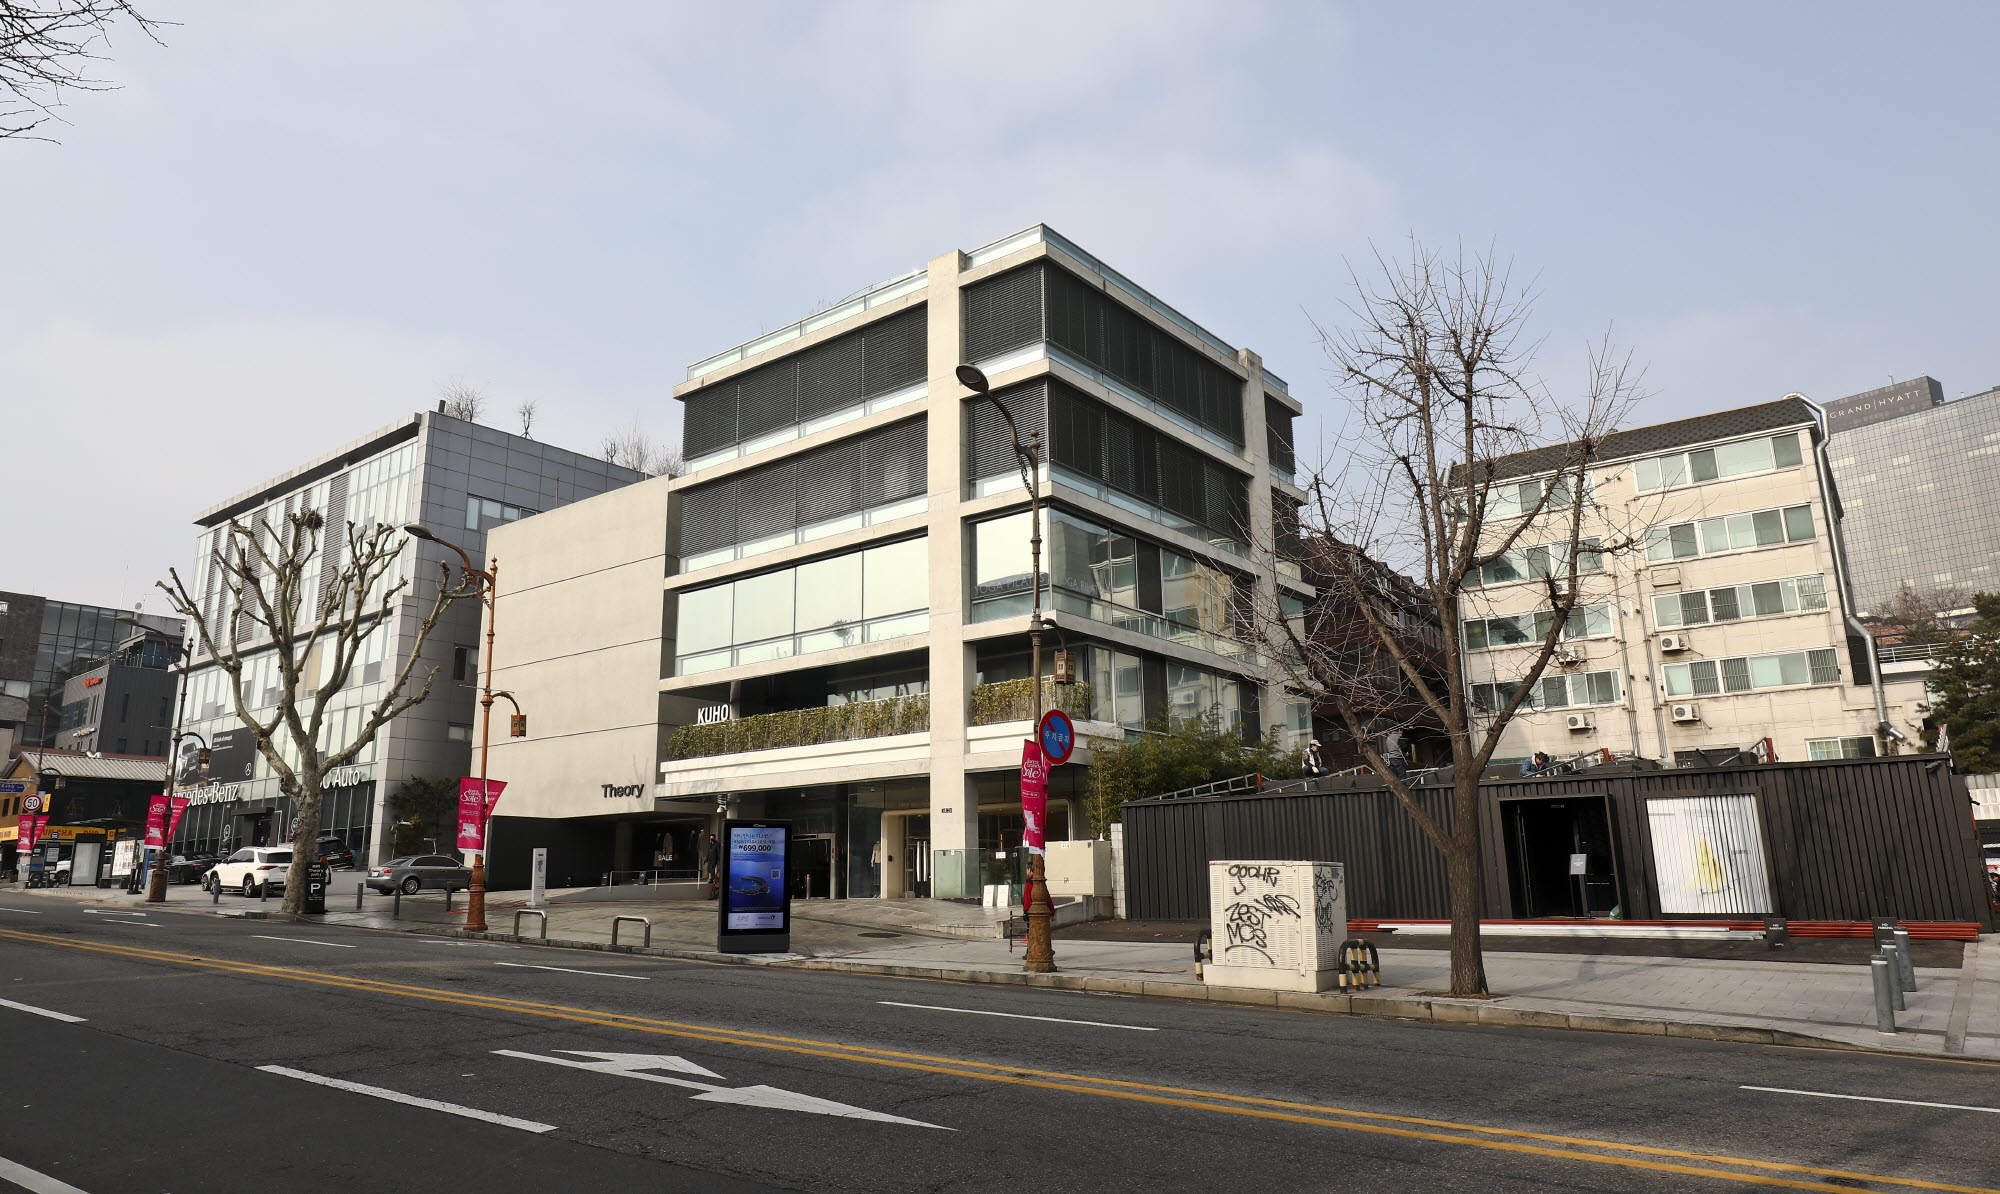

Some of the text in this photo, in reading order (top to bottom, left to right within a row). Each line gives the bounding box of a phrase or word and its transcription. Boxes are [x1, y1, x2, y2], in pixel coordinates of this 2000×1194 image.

[1829, 389, 1920, 419] GRAND HYATT
[697, 703, 729, 725] KUHO
[1044, 730, 1070, 743] 주차금지
[332, 766, 359, 788] Auto
[601, 783, 645, 799] Theory
[27, 798, 38, 808] 50
[310, 883, 321, 893] P
